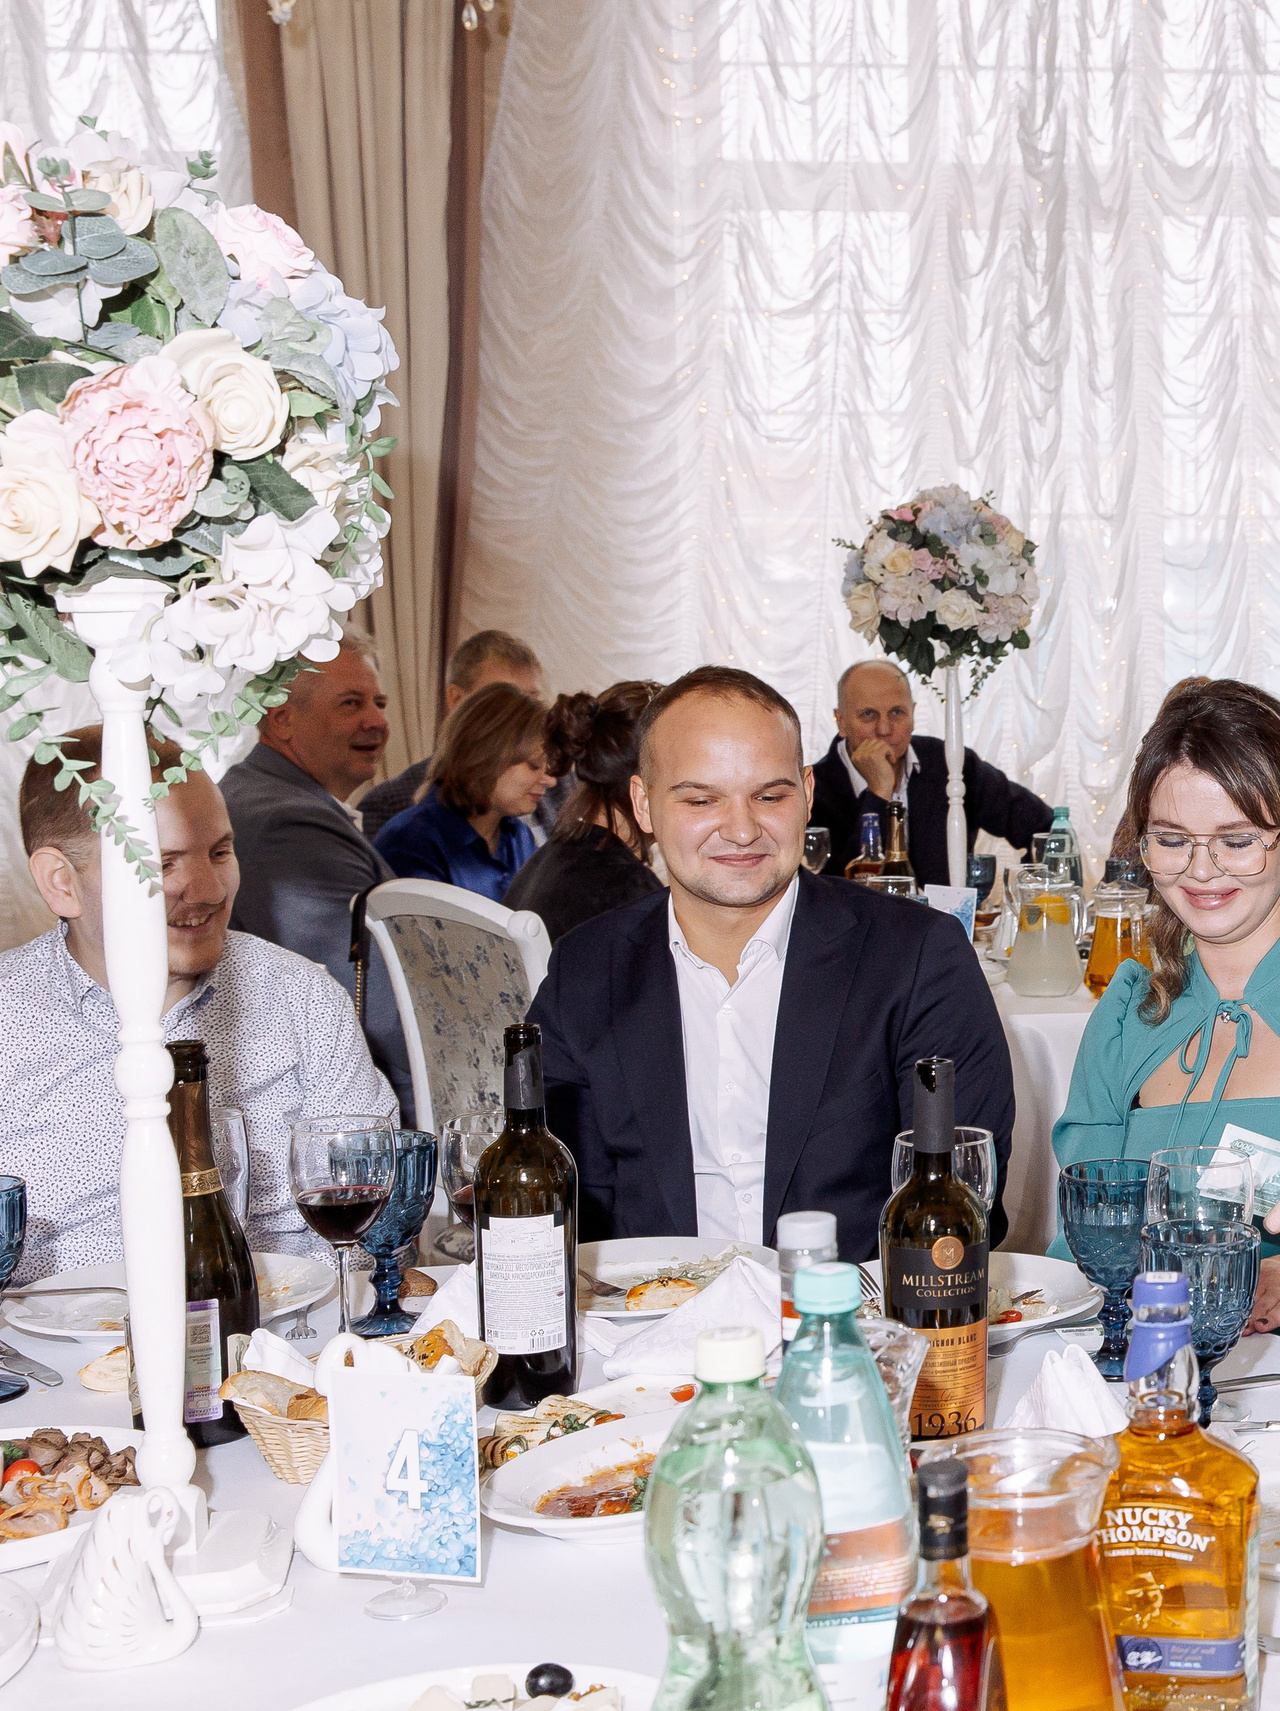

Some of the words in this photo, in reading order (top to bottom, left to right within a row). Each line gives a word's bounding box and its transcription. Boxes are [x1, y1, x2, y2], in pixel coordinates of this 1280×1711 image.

[1233, 1141, 1254, 1153] 1000
[902, 1268, 985, 1287] MILLSTREAM
[913, 1406, 977, 1438] 1936
[386, 1429, 429, 1510] 4
[1104, 1507, 1195, 1530] NUCKY
